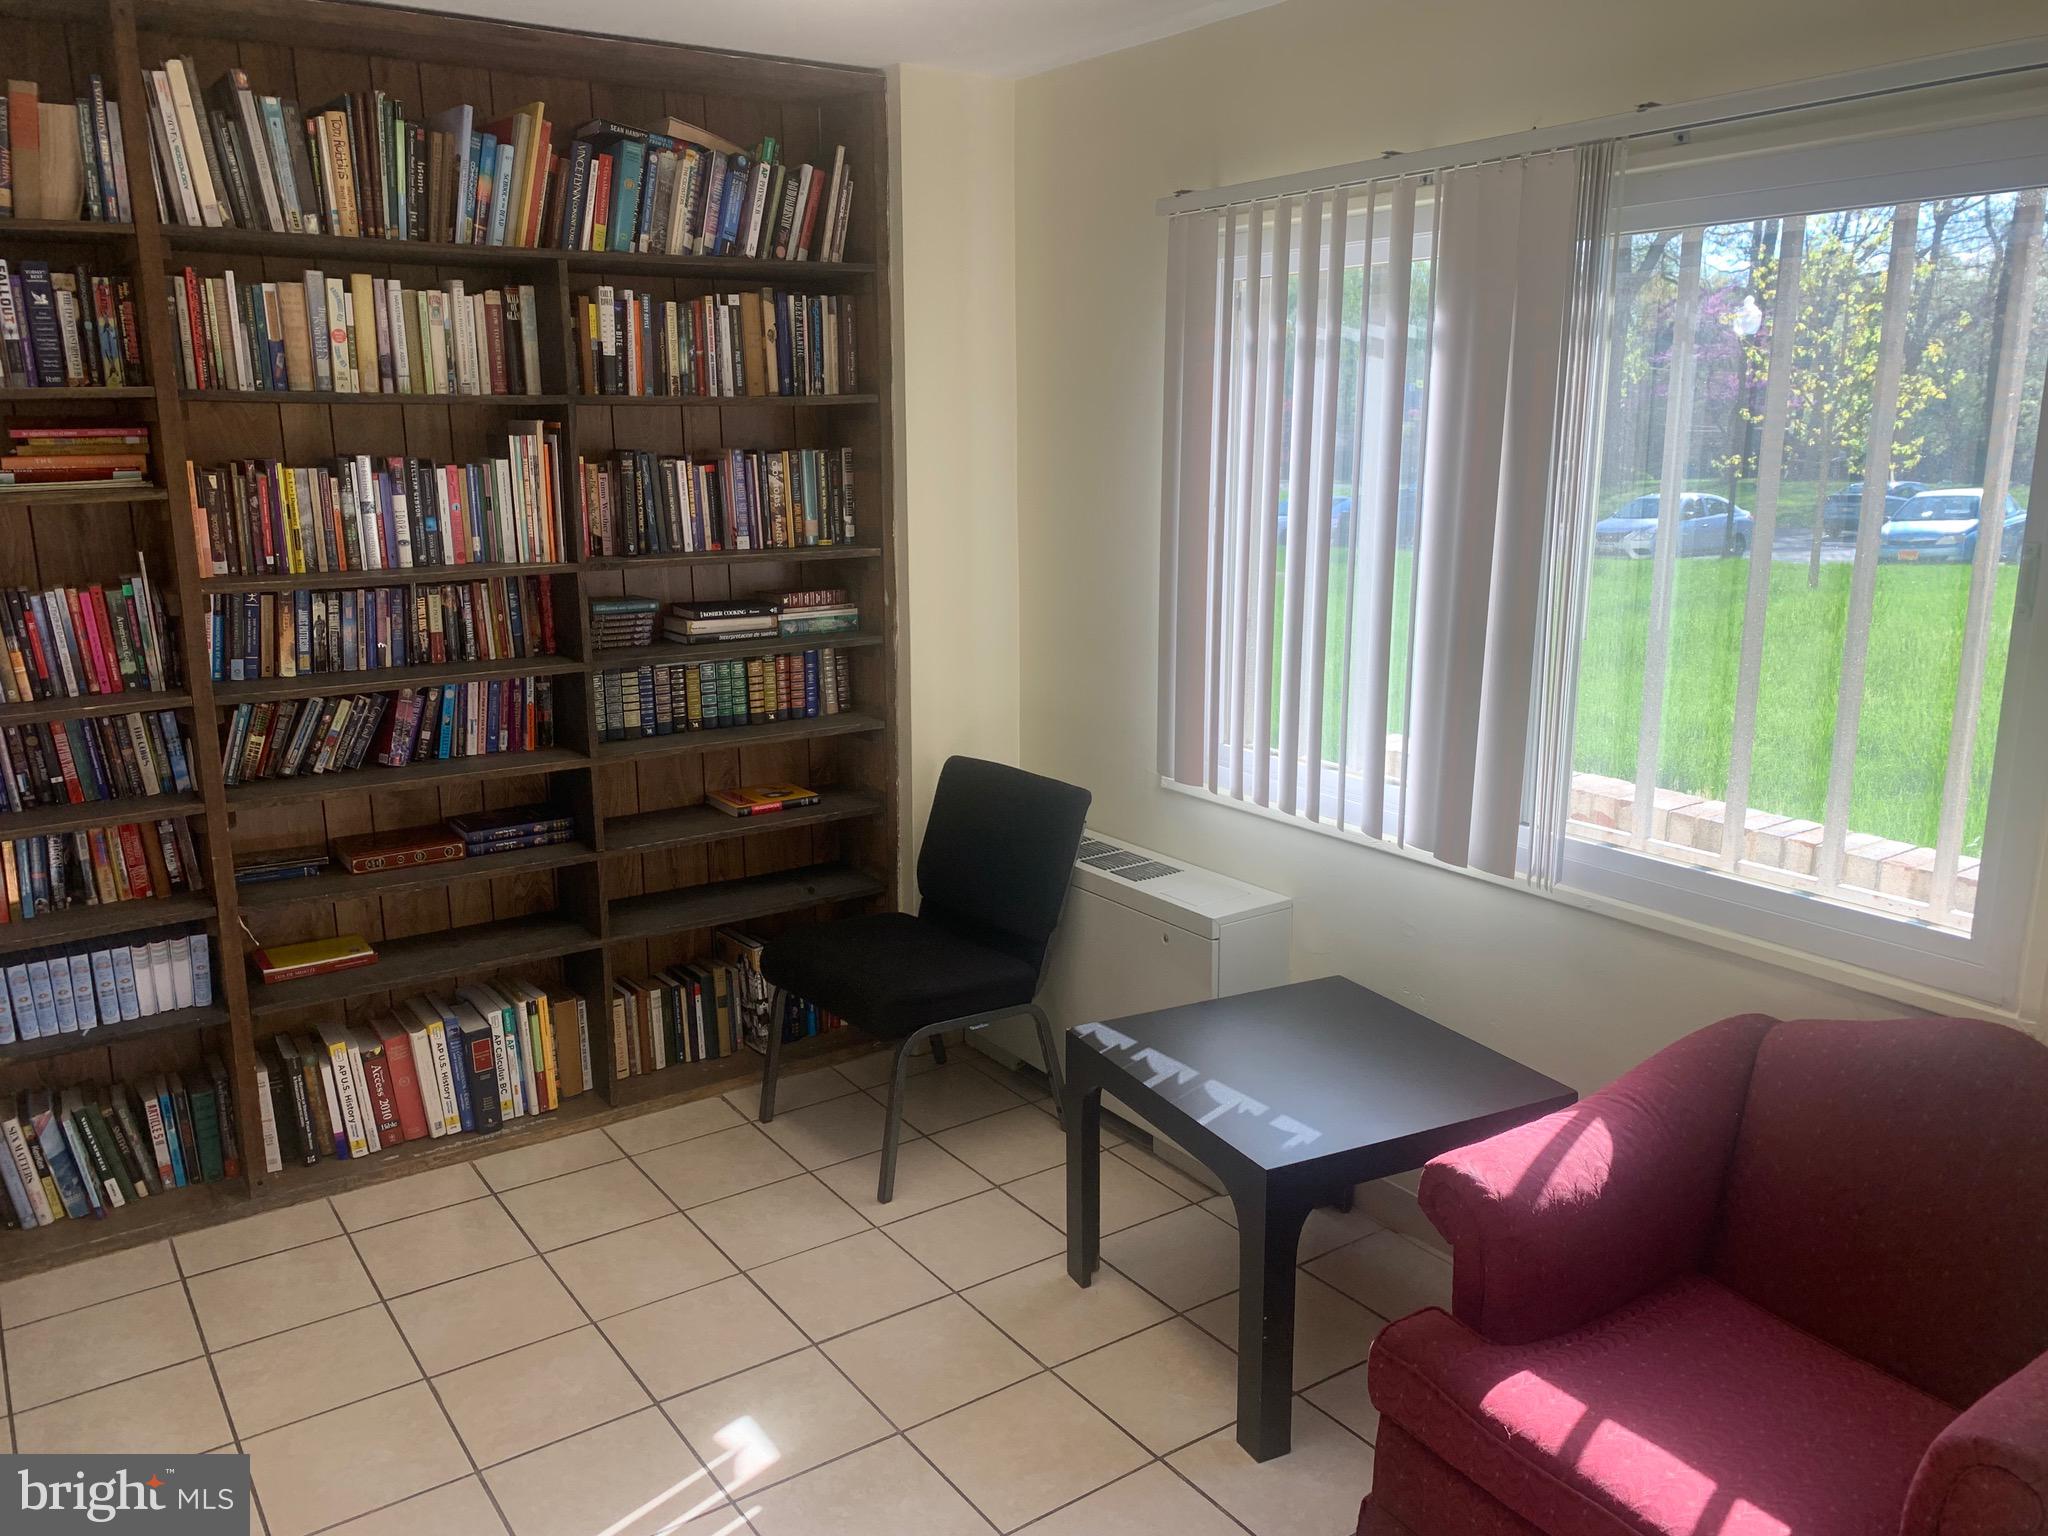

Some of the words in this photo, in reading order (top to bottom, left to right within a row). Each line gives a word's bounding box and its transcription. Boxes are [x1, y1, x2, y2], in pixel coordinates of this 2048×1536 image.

[331, 116, 343, 137] Tom
[610, 123, 627, 134] SEAN
[174, 145, 189, 189] SOCIOLOGY
[334, 140, 348, 180] Robbins
[575, 144, 586, 173] VINCE
[761, 167, 769, 178] AP
[466, 161, 476, 211] COMMUNICATION
[572, 174, 584, 201] FLYNN
[680, 178, 688, 205] CLOISTERS
[755, 181, 767, 208] PHYSICS
[292, 211, 300, 228] USED
[571, 201, 580, 224] CONSENT
[0, 265, 15, 324] FALLOUT
[63, 293, 71, 304] THE
[796, 323, 804, 358] ATLANTIC
[410, 460, 419, 490] WILLIAM
[771, 461, 782, 507] CROSSROADS
[599, 477, 608, 499] Funny
[395, 510, 405, 535] IDORU
[601, 502, 609, 533] Weather
[775, 514, 783, 547] FRANZEN
[298, 609, 309, 625] JAMES
[417, 597, 426, 618] STEPHEN
[723, 608, 747, 616] COOKING
[116, 616, 130, 650] American
[299, 626, 309, 652] PATTERSON
[366, 706, 381, 723] Cape
[134, 726, 145, 741] THE
[361, 723, 374, 738] Cod
[49, 837, 62, 867] GIDEON
[163, 842, 177, 876] MALCOLM
[436, 1042, 444, 1054] AP
[493, 1034, 502, 1046] AP
[507, 1039, 514, 1050] AP
[338, 1065, 348, 1076] AP
[438, 1055, 447, 1071] U.S.
[495, 1047, 505, 1081] Calculus
[340, 1077, 349, 1093] U.S.
[370, 1064, 385, 1097] Access
[378, 1098, 393, 1120] 2010
[442, 1072, 452, 1100] History
[500, 1083, 508, 1095] BC
[148, 1104, 162, 1133] ARTICLE
[343, 1095, 356, 1123] History
[8, 1126, 21, 1144] SEX
[14, 1145, 34, 1184] MATTERS
[31, 1145, 44, 1170] KenKen
